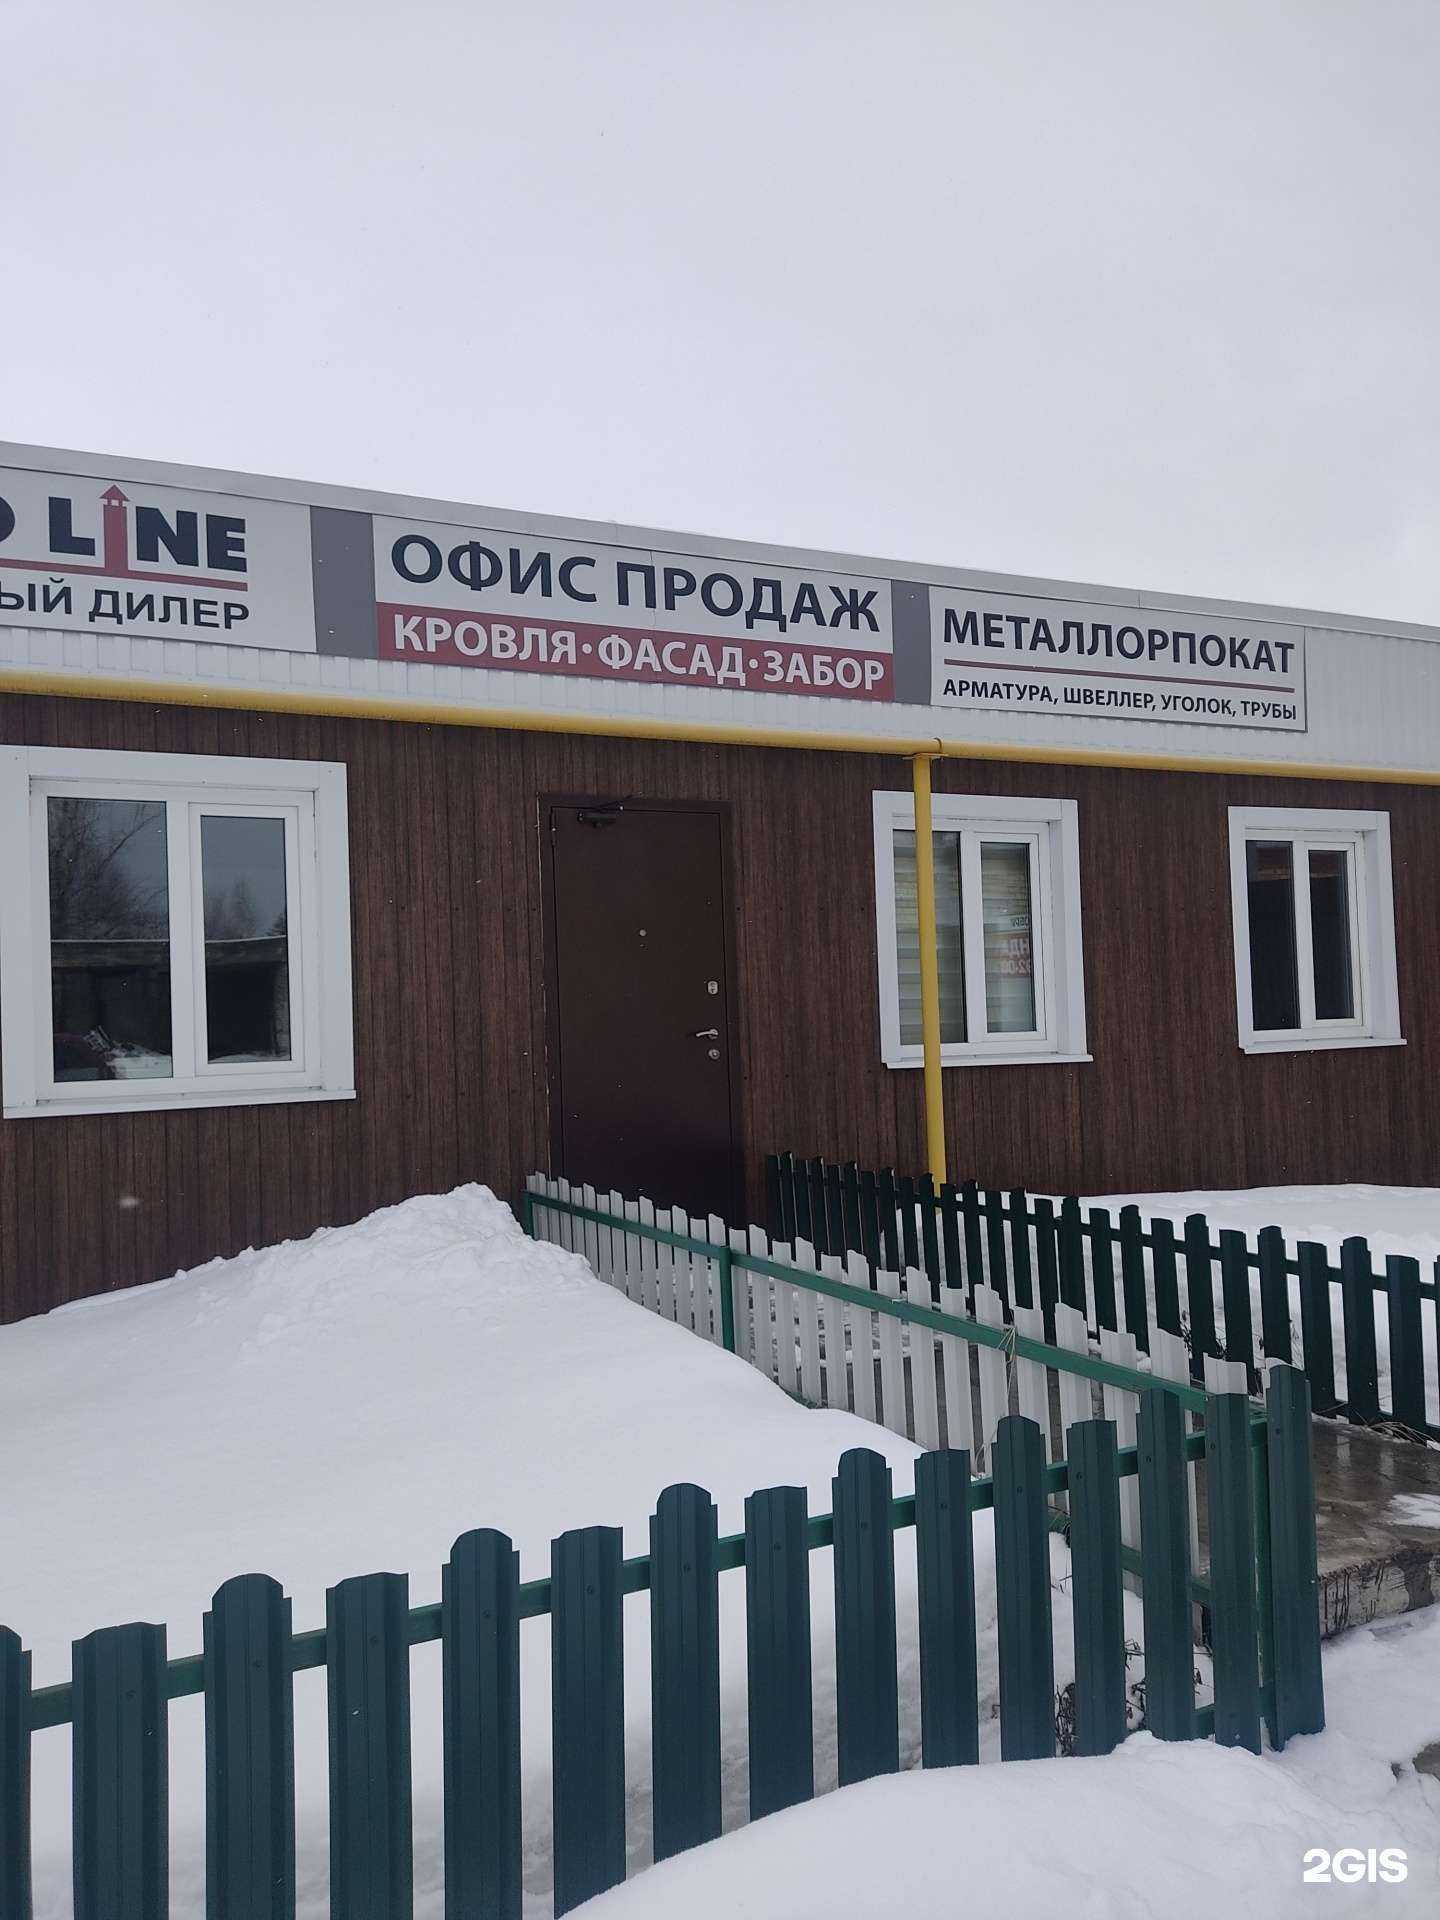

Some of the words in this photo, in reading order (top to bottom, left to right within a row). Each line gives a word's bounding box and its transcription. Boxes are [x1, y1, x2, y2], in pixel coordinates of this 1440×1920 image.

[88, 589, 250, 629] ДИЛЕР
[391, 534, 597, 603] ОФИС
[616, 561, 880, 632] ПРОДАЖ
[943, 607, 1295, 673] МЕТАЛЛОРПОКАТ
[943, 678, 1058, 706] АРМАТУРА,
[1063, 686, 1157, 712] ШВЕЛЛЕР,
[1161, 694, 1236, 717] УГОЛОК,
[1241, 700, 1297, 720] ТРУБЫ
